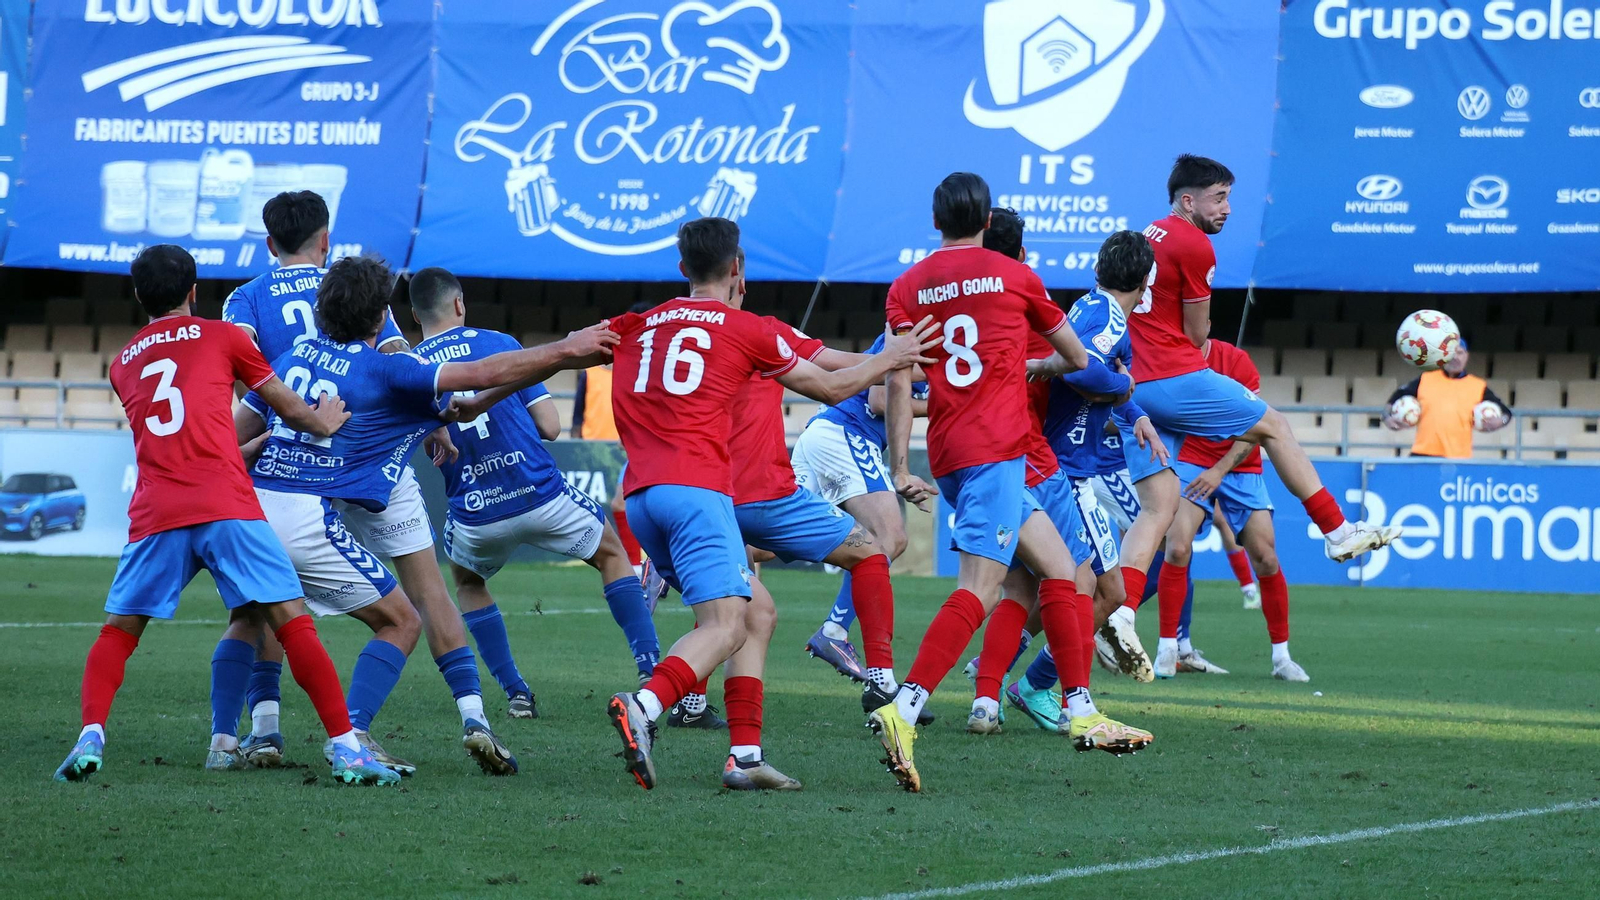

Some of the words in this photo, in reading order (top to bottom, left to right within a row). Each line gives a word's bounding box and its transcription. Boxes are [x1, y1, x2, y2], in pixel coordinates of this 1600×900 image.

[1313, 0, 1471, 50] Grupo
[558, 12, 708, 95] Bar
[301, 81, 353, 102] GRUPO
[353, 81, 380, 102] 3-J
[74, 117, 205, 144] FABRICANTES
[206, 120, 291, 145] PUENTES
[293, 121, 320, 146] DE
[321, 116, 381, 146] UNIÓN
[454, 92, 568, 166] La
[573, 99, 821, 166] Rotonda
[1354, 127, 1380, 139] Jerez
[1381, 127, 1414, 138] Motor
[1459, 126, 1492, 138] Solera
[1492, 127, 1525, 138] Motor
[1019, 155, 1095, 185] ITS
[609, 192, 650, 212] 1998
[997, 195, 1109, 213] SERVICIOS
[1345, 200, 1409, 214] HYUNDAI
[594, 215, 612, 231] de
[611, 217, 629, 232] la
[1331, 221, 1382, 234] Guadalete
[1382, 222, 1416, 234] Motor
[1484, 222, 1517, 235] Motor
[1413, 260, 1540, 276] www.gruposolera.net
[269, 275, 323, 297] SALGUE
[918, 282, 959, 304] NACHO
[962, 276, 1004, 296] GOMA
[416, 333, 460, 355] indeso
[428, 342, 472, 364] HUGO
[942, 314, 983, 387] 8
[316, 351, 351, 377] PLAZA
[633, 326, 712, 395] 16
[139, 357, 186, 437] 3
[482, 485, 503, 498] High
[485, 484, 537, 507] ProNutrition
[1440, 475, 1539, 504] clínicas
[1089, 506, 1109, 538] 19
